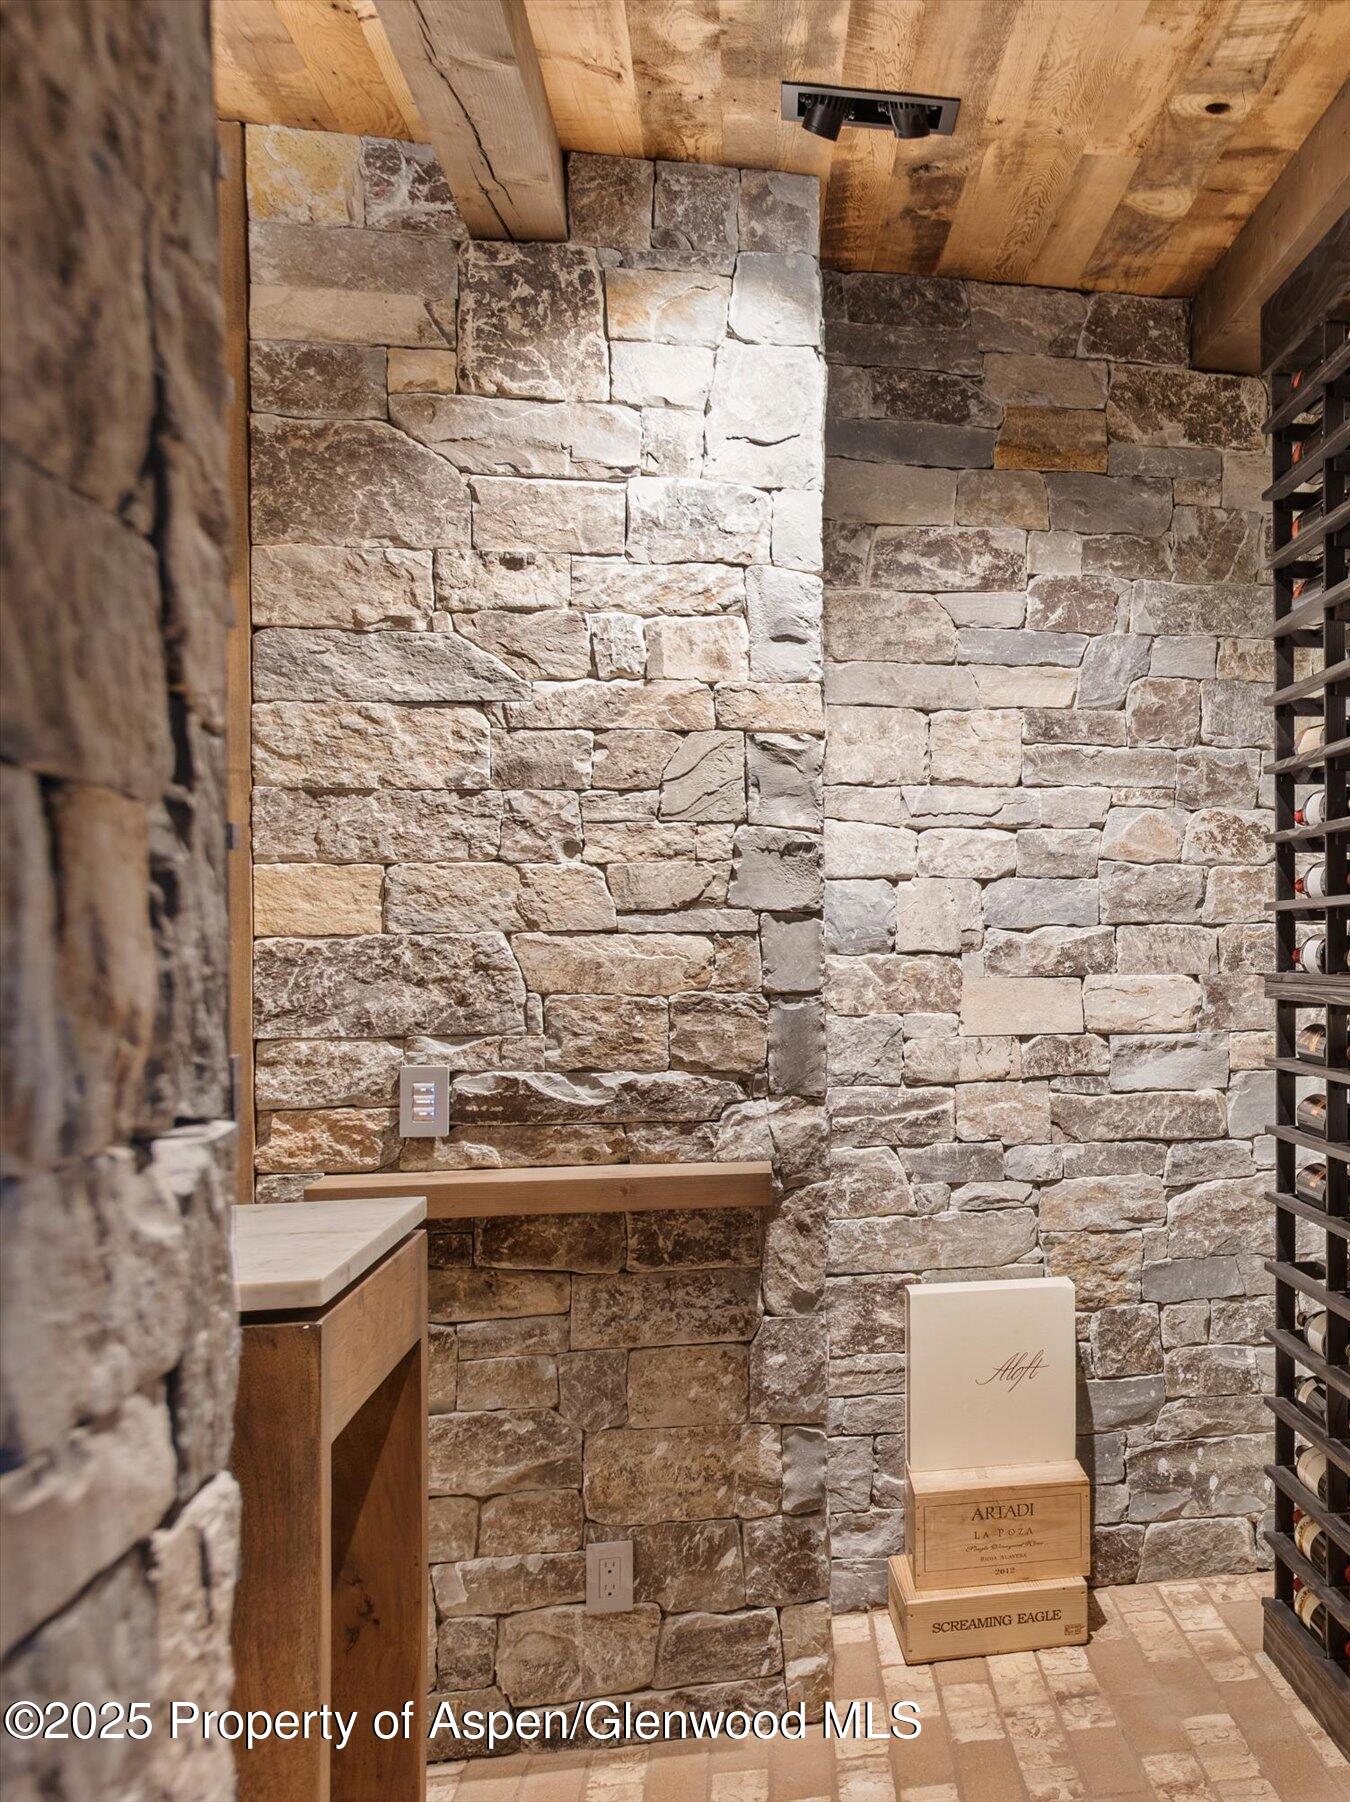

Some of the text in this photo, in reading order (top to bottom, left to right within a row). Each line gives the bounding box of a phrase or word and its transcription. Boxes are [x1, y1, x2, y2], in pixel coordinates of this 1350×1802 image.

[975, 1348, 1050, 1393] Aloft
[971, 1503, 1035, 1521] ARTADI
[974, 1527, 1034, 1540] LA POZA
[995, 1567, 1016, 1576] 2012
[932, 1609, 1062, 1634] SCREAMING EAGLE
